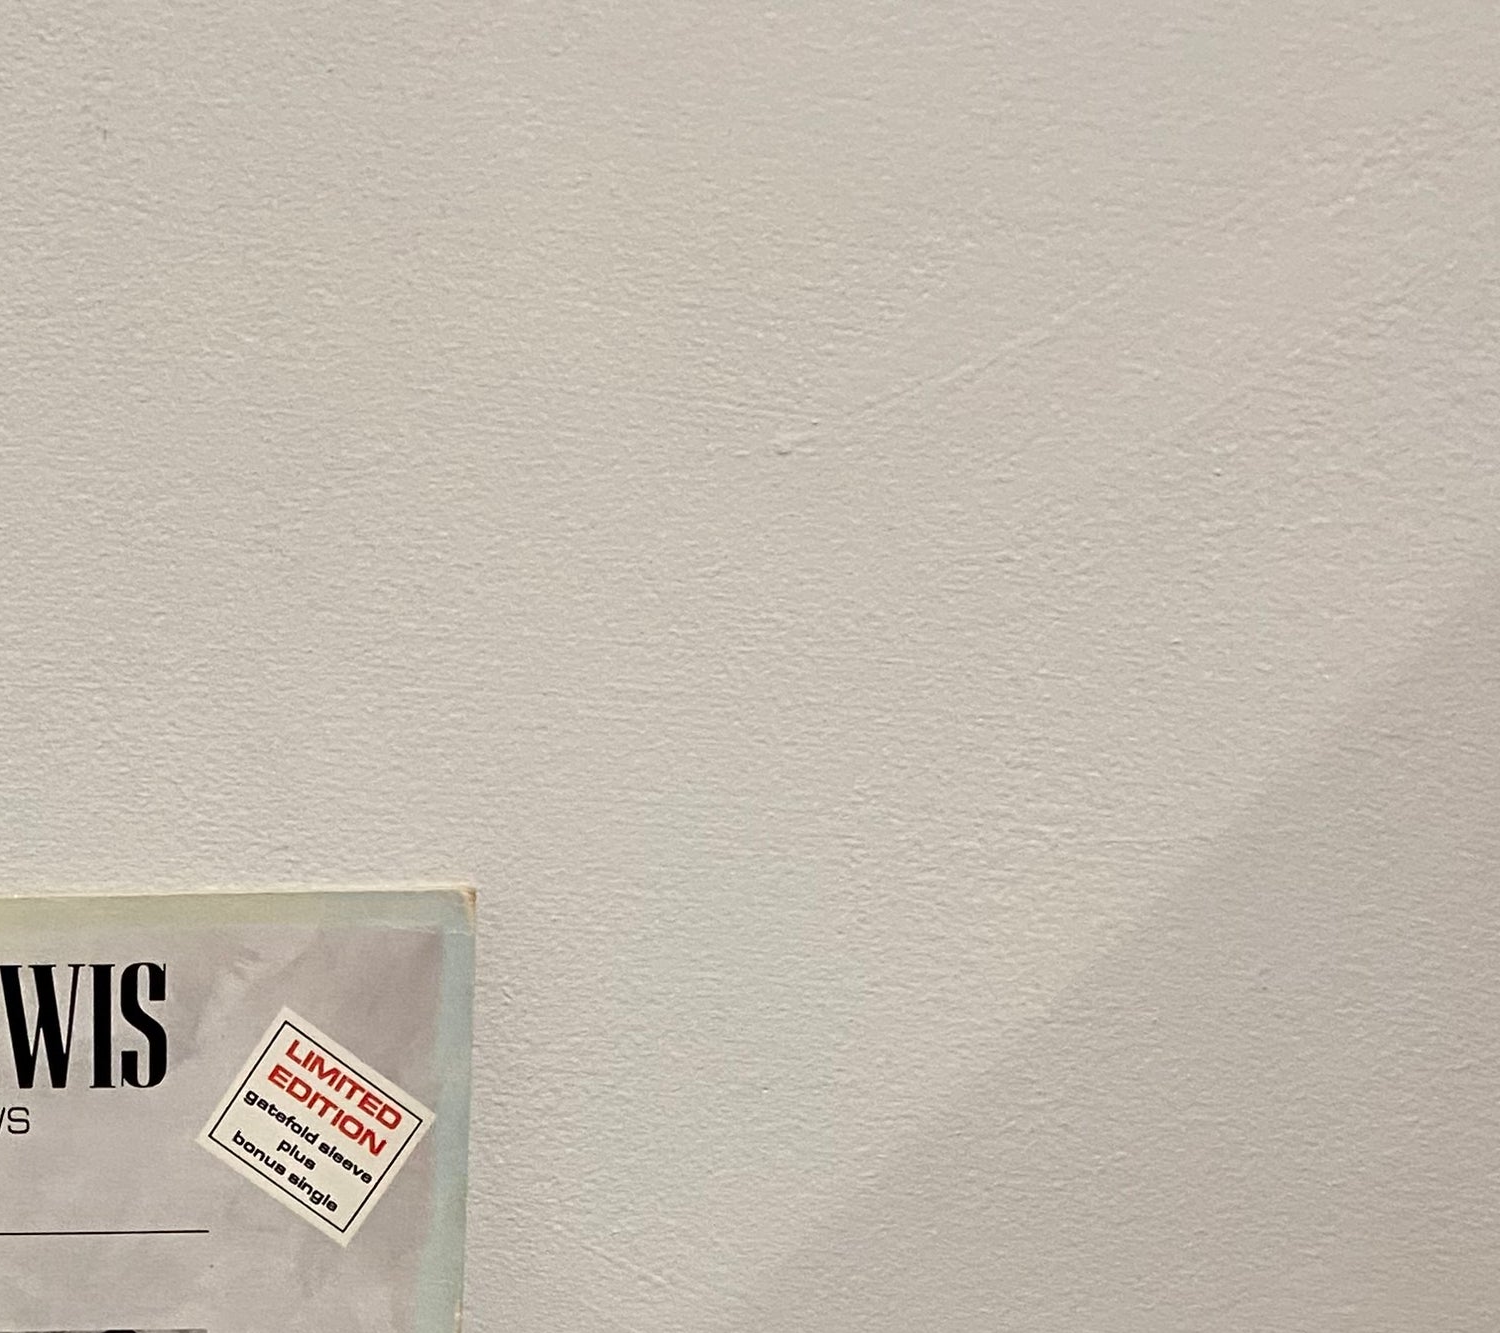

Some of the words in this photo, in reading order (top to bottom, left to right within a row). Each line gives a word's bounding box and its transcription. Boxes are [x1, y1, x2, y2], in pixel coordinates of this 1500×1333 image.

[267, 1064, 387, 1156] EDITION
[285, 1040, 402, 1130] LIMITED
[232, 1130, 287, 1176] bonus
[288, 1172, 338, 1212] single
[243, 1090, 319, 1145] gatefold
[318, 1141, 373, 1184] sleeve
[276, 1139, 316, 1170] plus
